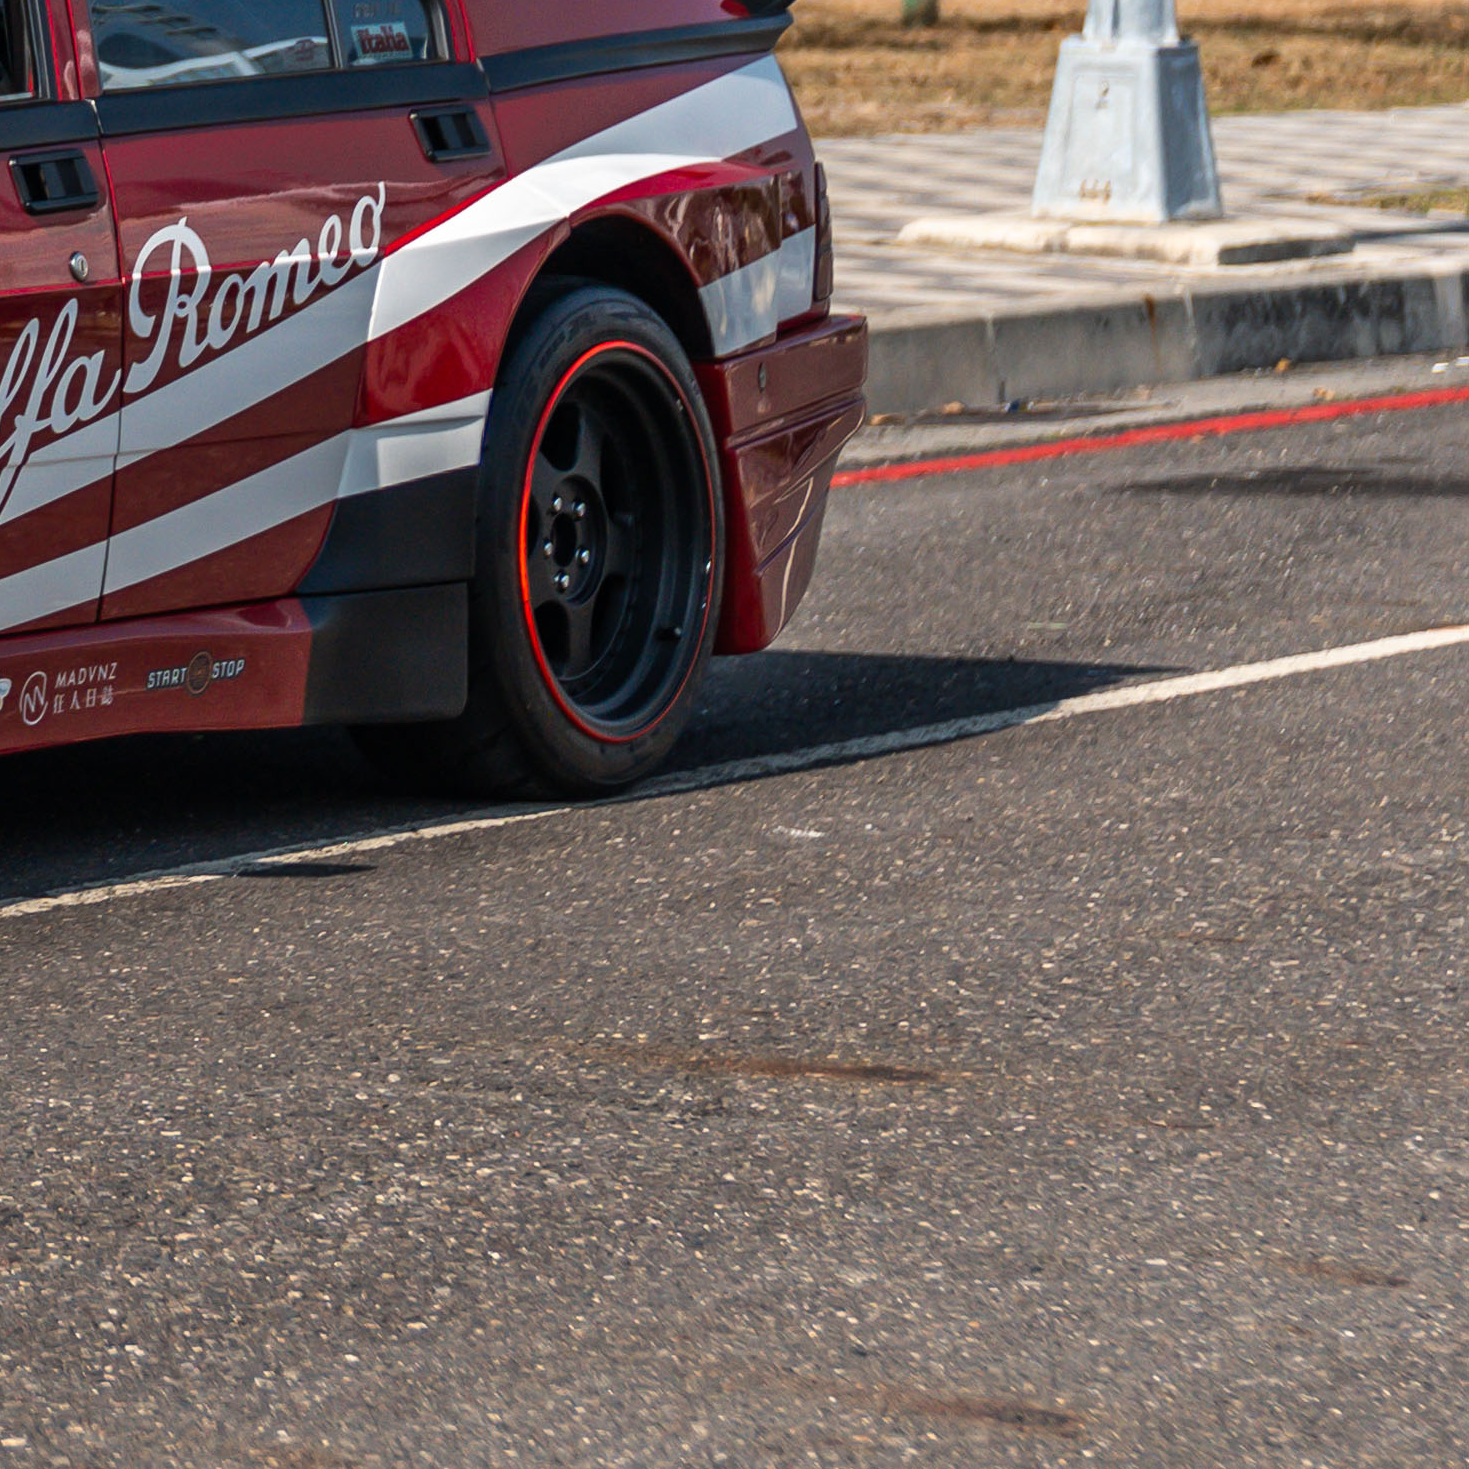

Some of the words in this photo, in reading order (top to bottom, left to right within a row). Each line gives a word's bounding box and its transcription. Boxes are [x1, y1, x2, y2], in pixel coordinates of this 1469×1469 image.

[120, 181, 387, 395] Romeo
[55, 662, 118, 689] MADVNZ
[146, 666, 188, 690] START
[211, 658, 246, 682] STOP
